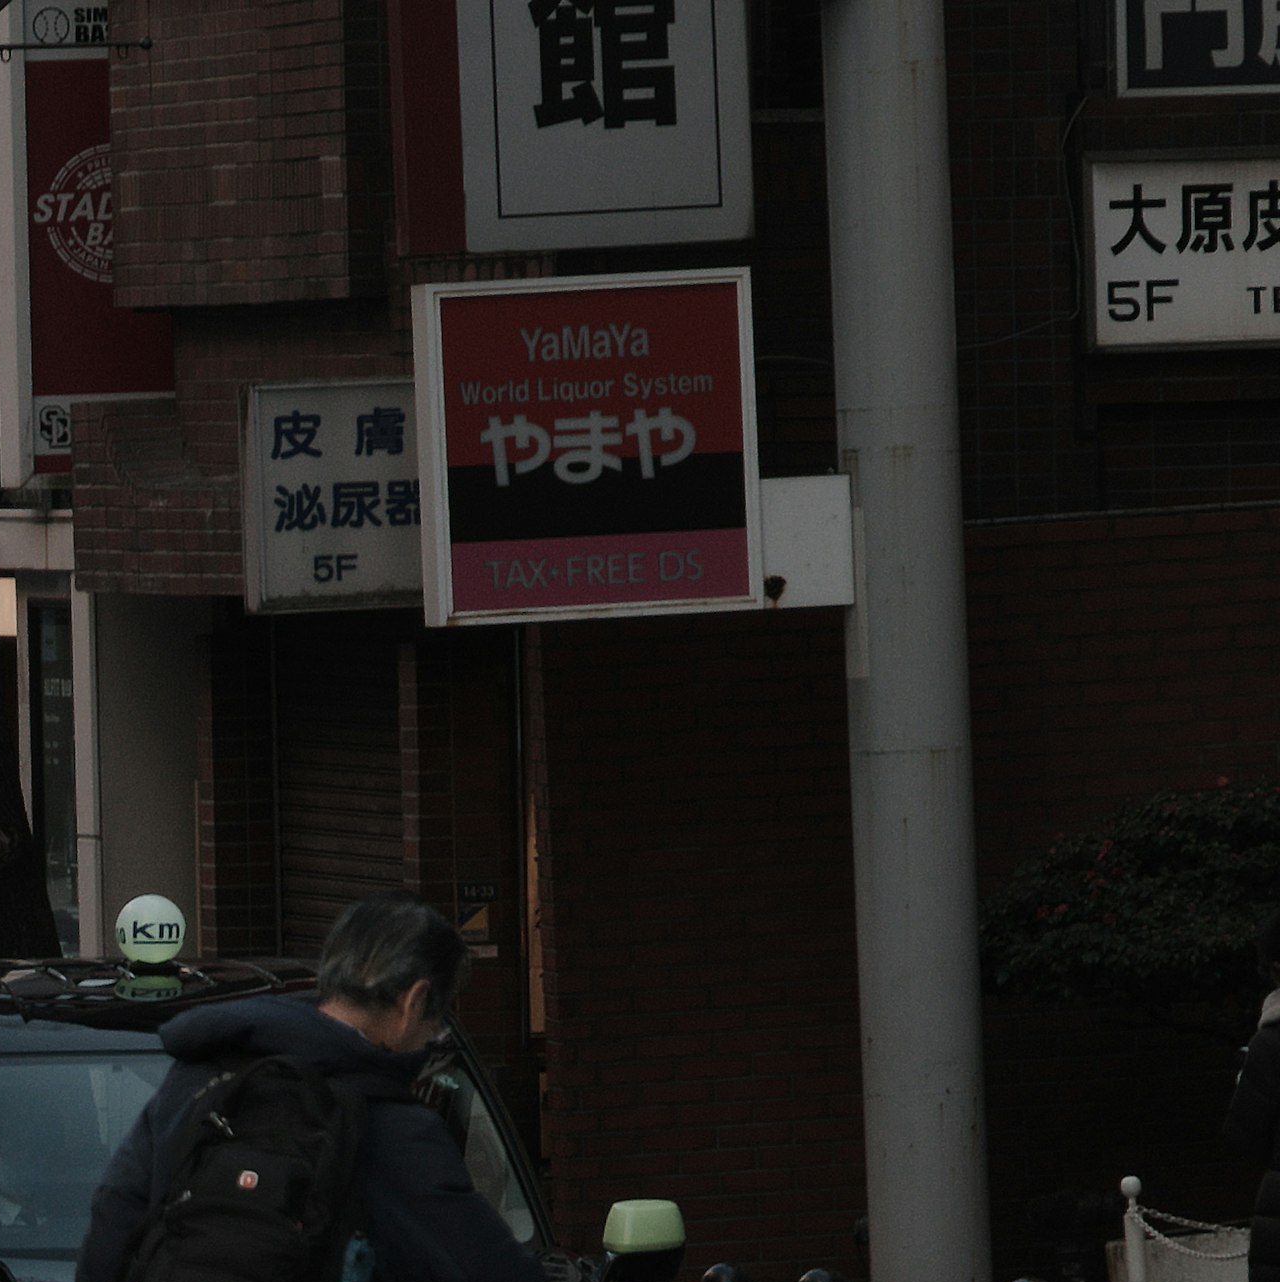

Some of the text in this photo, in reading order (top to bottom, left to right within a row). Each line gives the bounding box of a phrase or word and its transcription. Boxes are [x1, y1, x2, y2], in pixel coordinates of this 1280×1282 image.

[1107, 279, 1179, 322] 5F
[520, 321, 650, 363] YaMaYa
[459, 372, 714, 406] World Liquor System
[271, 407, 406, 460] 皮膚
[480, 405, 698, 488] やまや
[313, 554, 359, 583] 5F
[659, 548, 705, 583] DS
[132, 921, 180, 939] km
